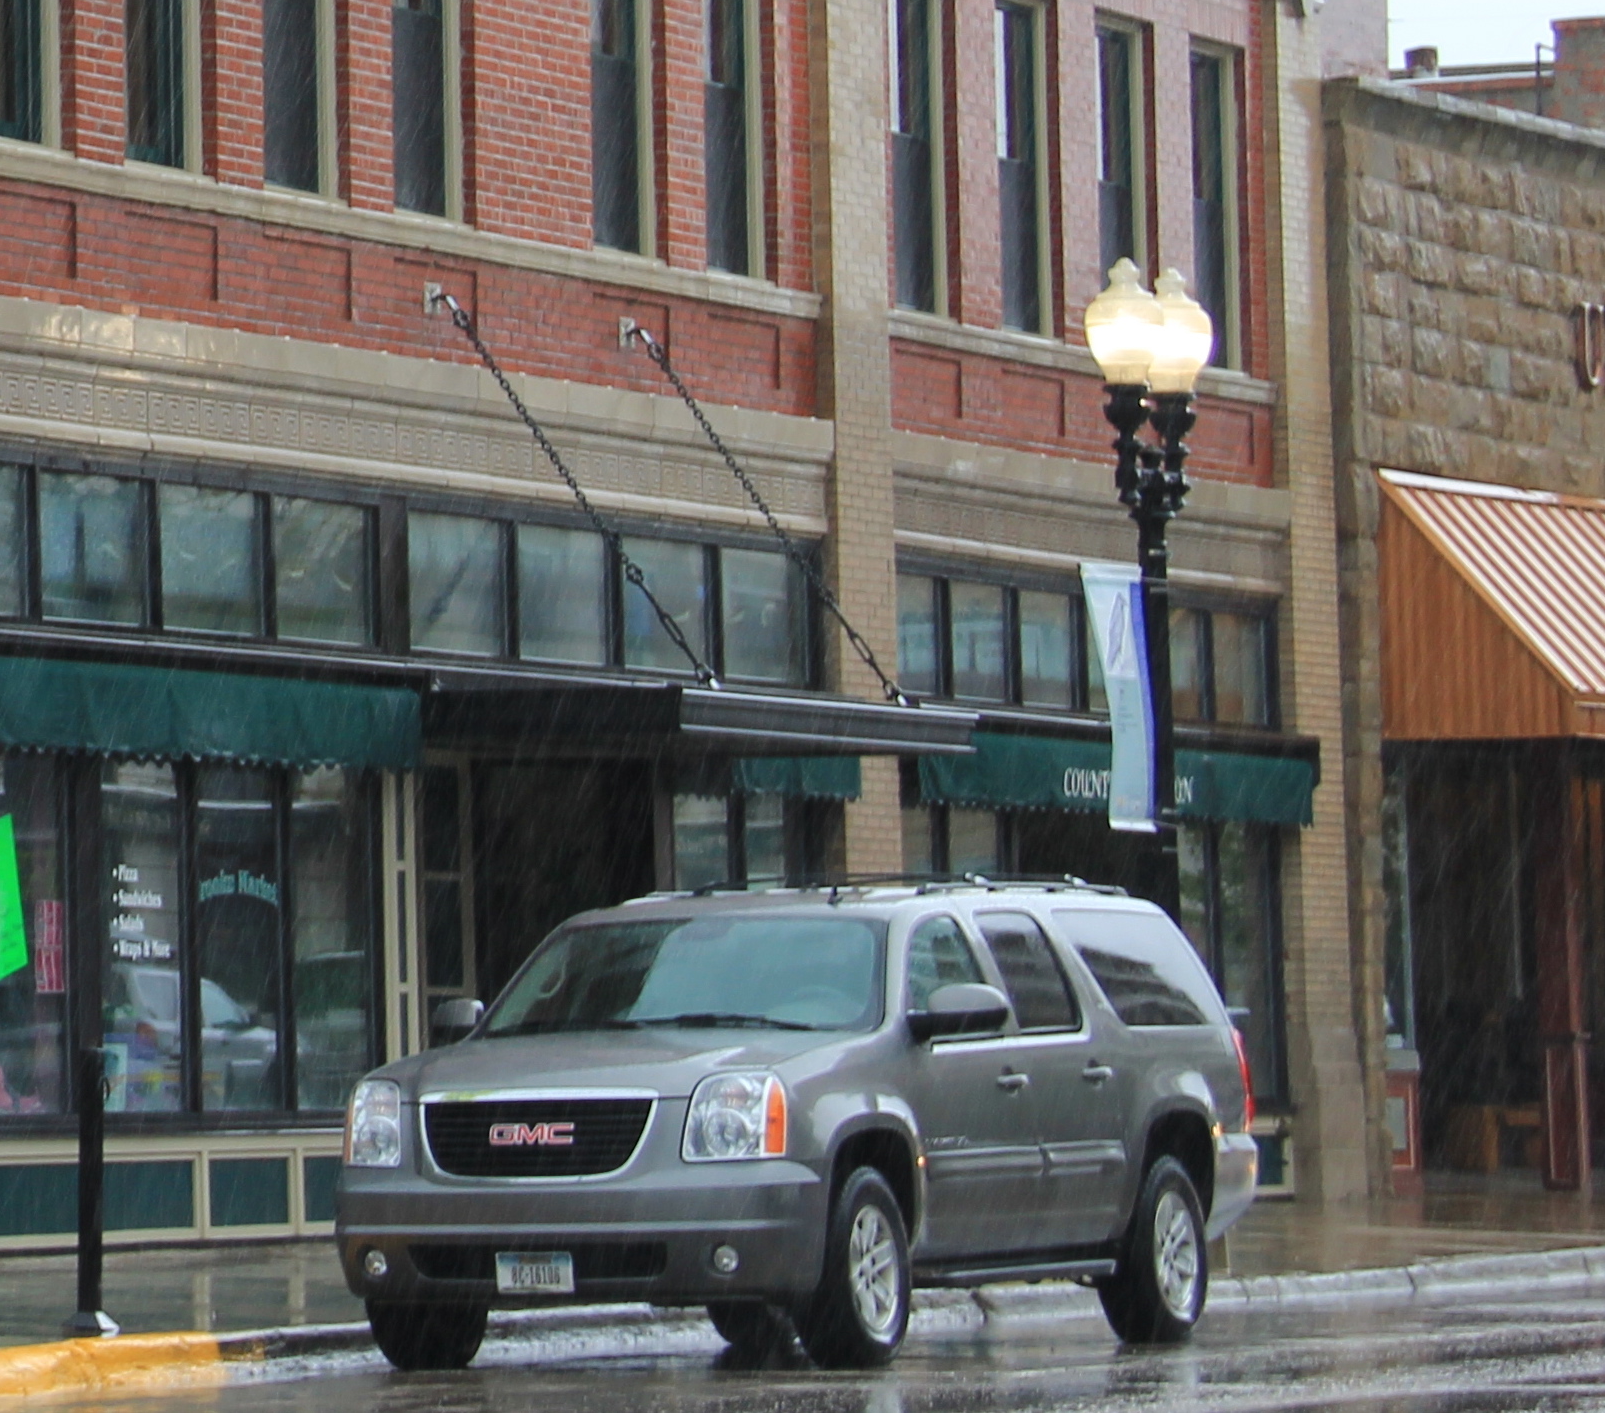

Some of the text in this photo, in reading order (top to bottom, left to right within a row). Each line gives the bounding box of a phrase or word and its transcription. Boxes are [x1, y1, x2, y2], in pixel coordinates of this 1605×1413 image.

[1063, 767, 1110, 799] COUNT
[198, 868, 236, 902] rooks
[489, 1122, 575, 1146] GMC
